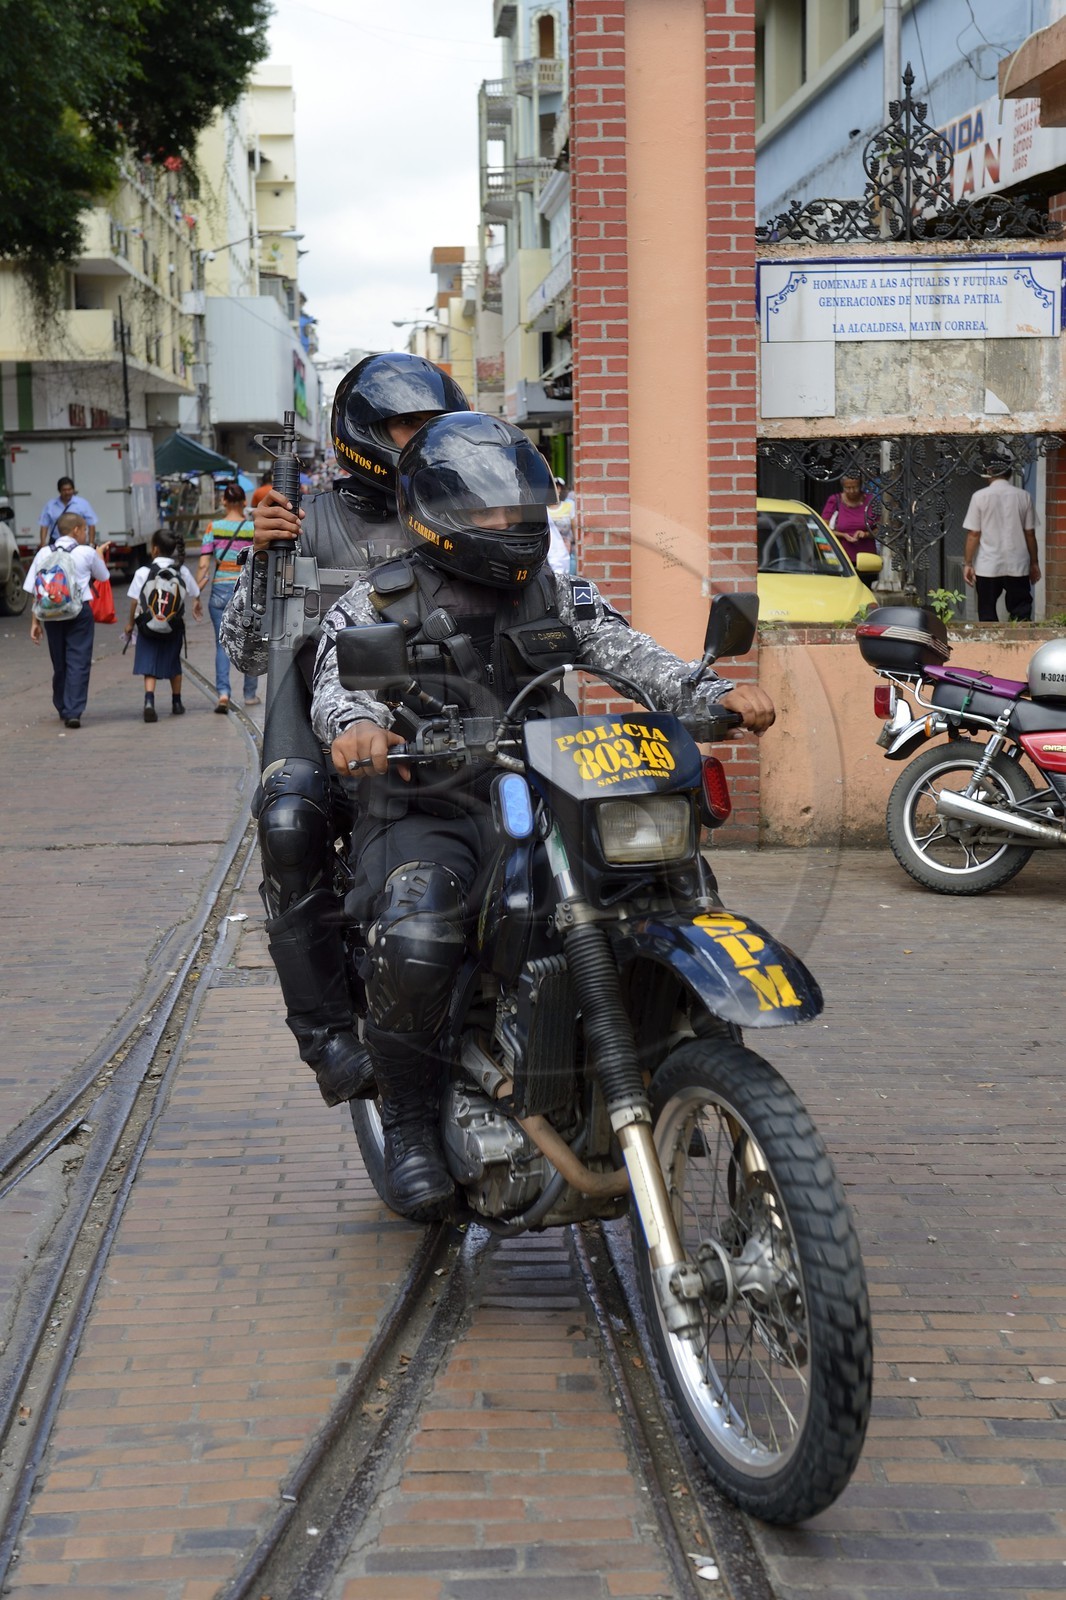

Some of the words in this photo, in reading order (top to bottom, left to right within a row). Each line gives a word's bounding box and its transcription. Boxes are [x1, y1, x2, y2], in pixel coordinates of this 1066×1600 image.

[1014, 103, 1029, 121] POLLO
[1013, 119, 1033, 139] CHICHAS
[1013, 135, 1033, 157] BATIDOS
[1012, 154, 1028, 173] JUGOS
[813, 279, 868, 289] HOMENAJE
[870, 279, 877, 288] A
[880, 278, 898, 288] LAS
[900, 277, 950, 287] ACTUALES
[953, 277, 960, 286] Y
[963, 276, 1008, 286] FUTURAS
[819, 296, 896, 307] GENERACIONES
[898, 295, 912, 305] DE
[915, 294, 961, 305] NUESTRA
[964, 294, 1003, 304] PATRIA.
[833, 324, 845, 333] LA
[848, 322, 907, 333] ALCALDESA,
[910, 321, 942, 331] MAYIN
[944, 321, 988, 331] CORREA.
[413, 520, 440, 546] CARRERA
[516, 569, 528, 581] 13
[555, 723, 669, 752] POLICIA
[573, 738, 676, 781] 80349
[597, 774, 620, 788] SAN
[622, 768, 671, 781] ANTONIO
